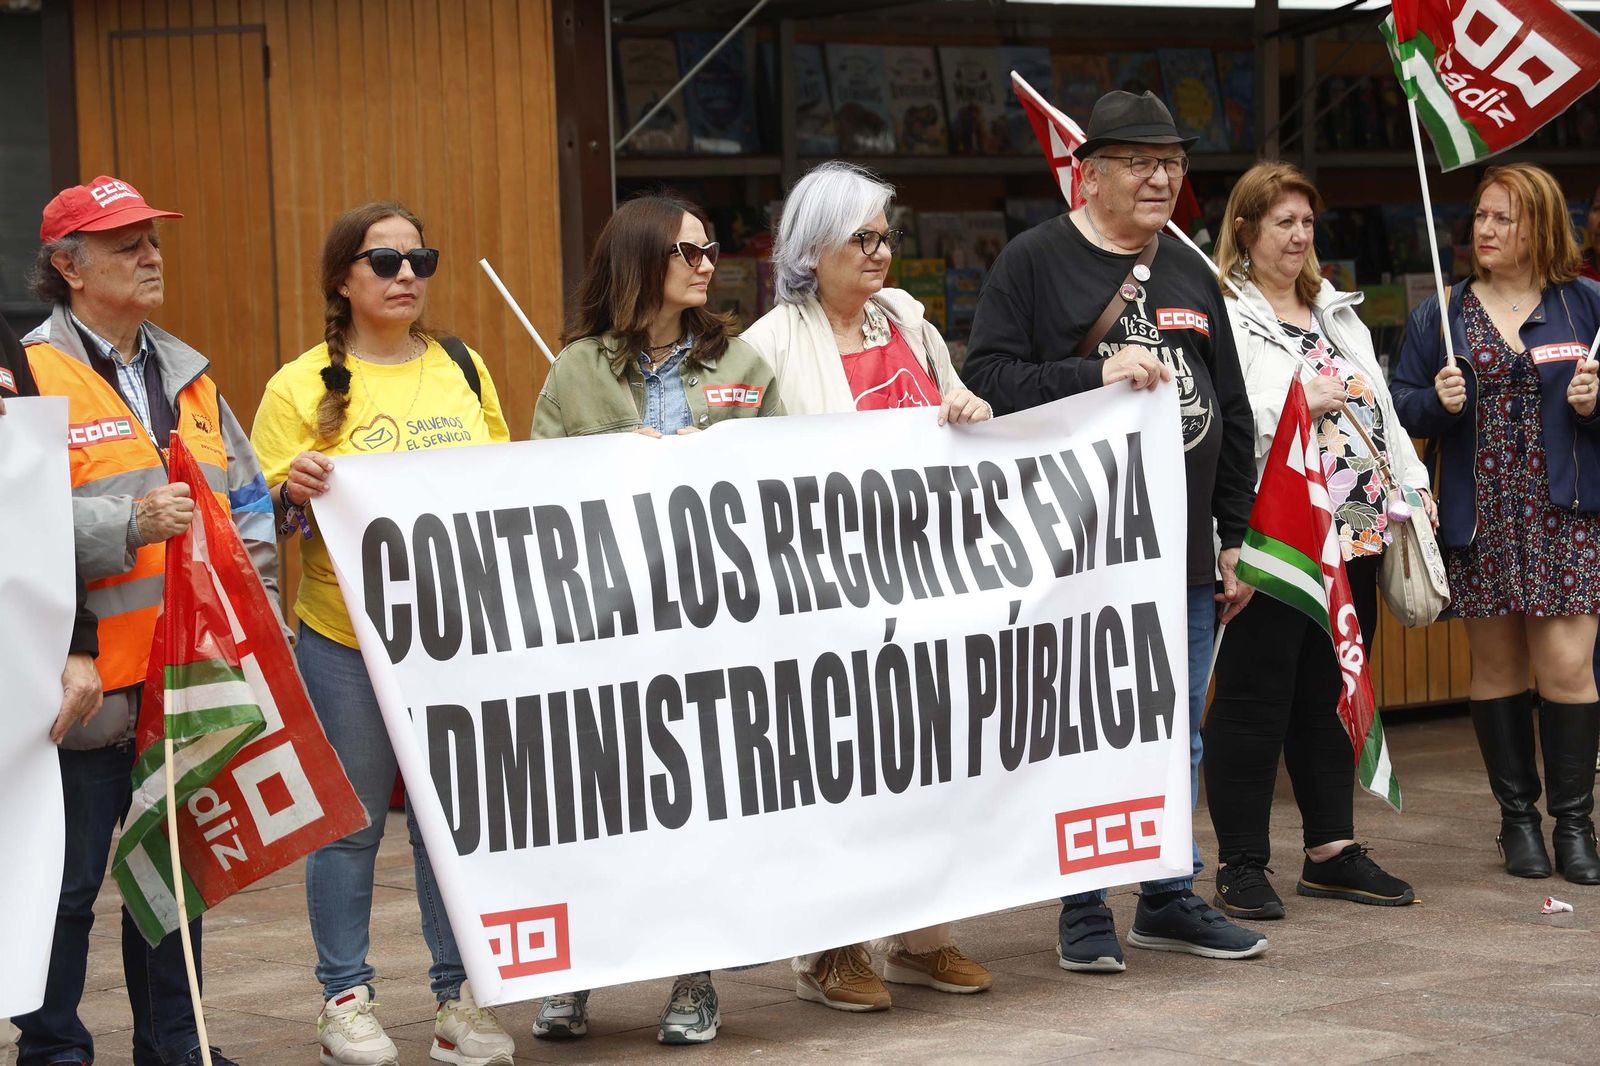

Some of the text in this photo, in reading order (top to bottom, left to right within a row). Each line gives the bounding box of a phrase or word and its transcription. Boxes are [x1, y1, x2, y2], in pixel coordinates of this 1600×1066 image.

[91, 181, 133, 201] CCO
[1159, 312, 1203, 331] CCOO
[1533, 345, 1583, 361] CCOO
[406, 416, 464, 436] SALVEMOS
[406, 430, 472, 451] EL SERVICIO
[362, 499, 639, 665] CONTRA
[632, 480, 761, 632] LOS
[757, 460, 1034, 616] RECORTES
[1014, 449, 1099, 579] EN
[1092, 431, 1161, 566] LA
[408, 617, 952, 857] DMINISTRACIÓN
[964, 600, 1177, 778] PÚBLICA
